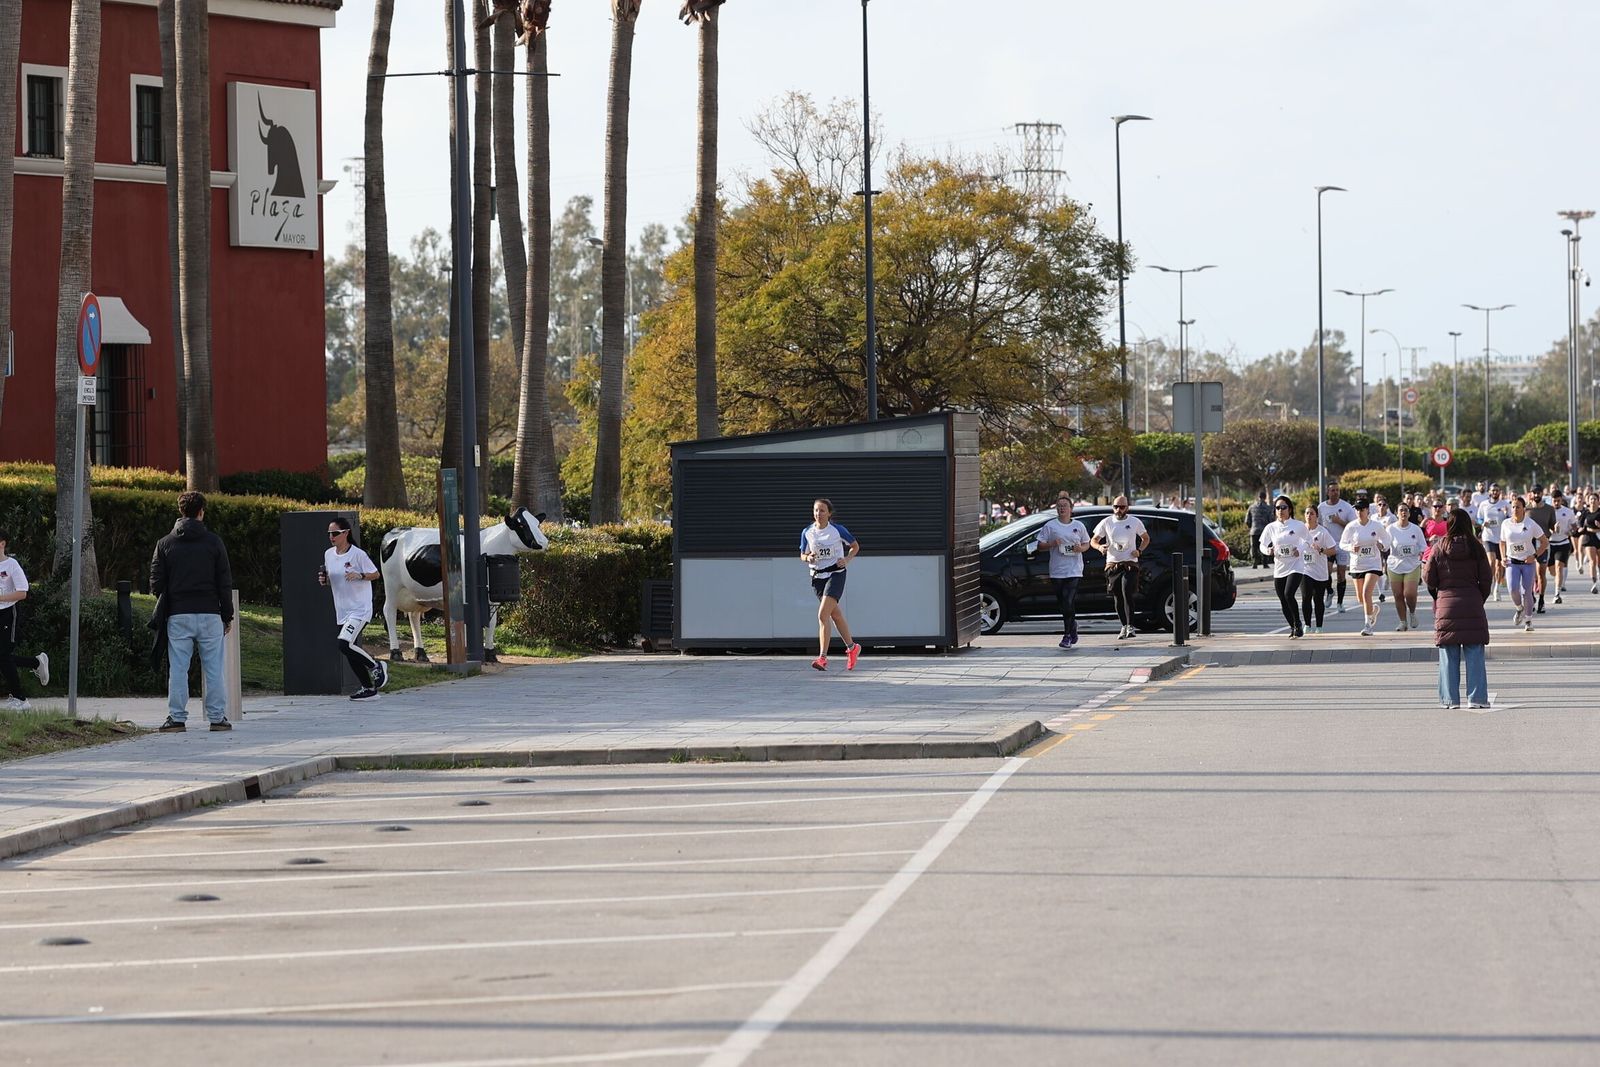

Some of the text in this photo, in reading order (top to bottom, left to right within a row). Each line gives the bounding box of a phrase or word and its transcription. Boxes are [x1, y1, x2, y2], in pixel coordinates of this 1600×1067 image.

[250, 187, 304, 242] Plaza
[282, 233, 306, 245] MAYOR
[818, 547, 831, 556] 212
[1360, 547, 1372, 555] 407
